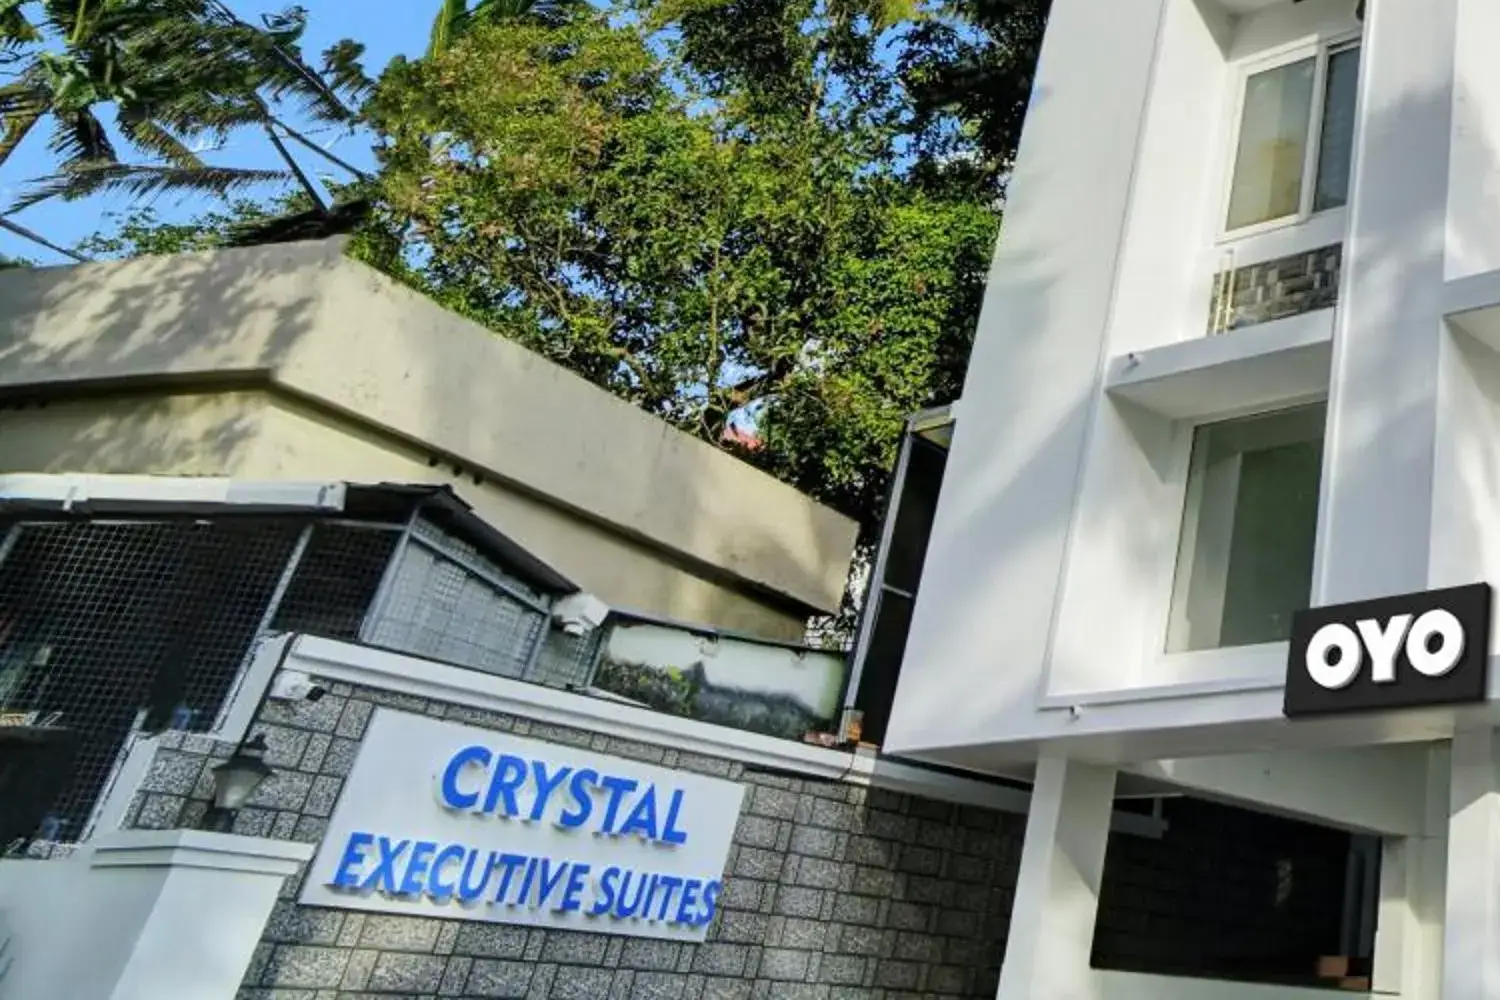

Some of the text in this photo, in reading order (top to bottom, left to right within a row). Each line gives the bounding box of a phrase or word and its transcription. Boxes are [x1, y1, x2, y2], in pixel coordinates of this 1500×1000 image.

[1306, 608, 1465, 690] OYO
[441, 746, 688, 845] CRYSTAL
[333, 831, 722, 926] EXECUTIVE SUITES
